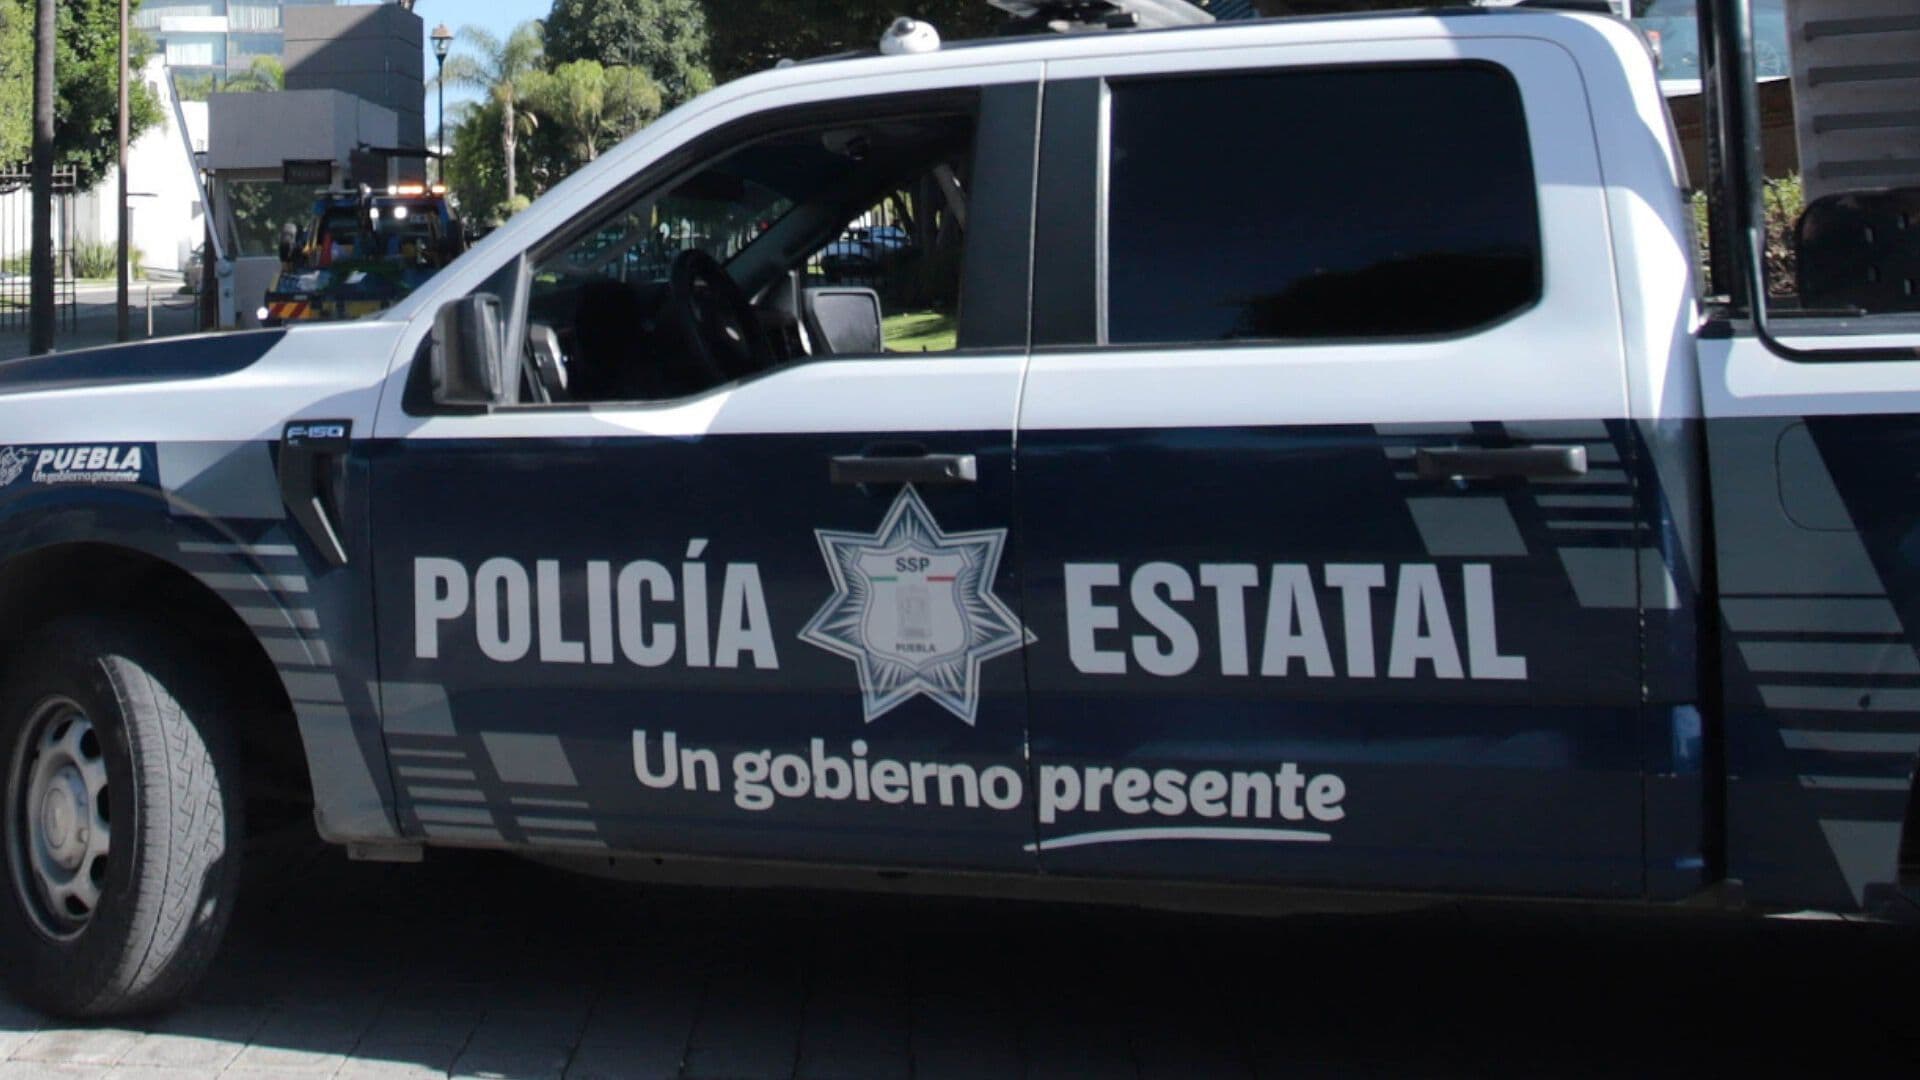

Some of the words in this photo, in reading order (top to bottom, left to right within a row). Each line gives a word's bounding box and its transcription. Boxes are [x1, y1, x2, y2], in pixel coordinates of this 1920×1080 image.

[287, 425, 345, 438] F-150
[34, 446, 142, 472] PUEBLA
[32, 471, 46, 482] Un
[46, 470, 91, 485] gobierno
[91, 471, 139, 484] presente
[895, 556, 930, 573] SSP
[414, 537, 779, 670] POLICÍA
[1064, 562, 1528, 681] ESTATAL
[895, 642, 936, 653] PUEBLA
[632, 729, 721, 793] Un
[732, 737, 1023, 811] gobierno
[1039, 762, 1346, 825] presente
